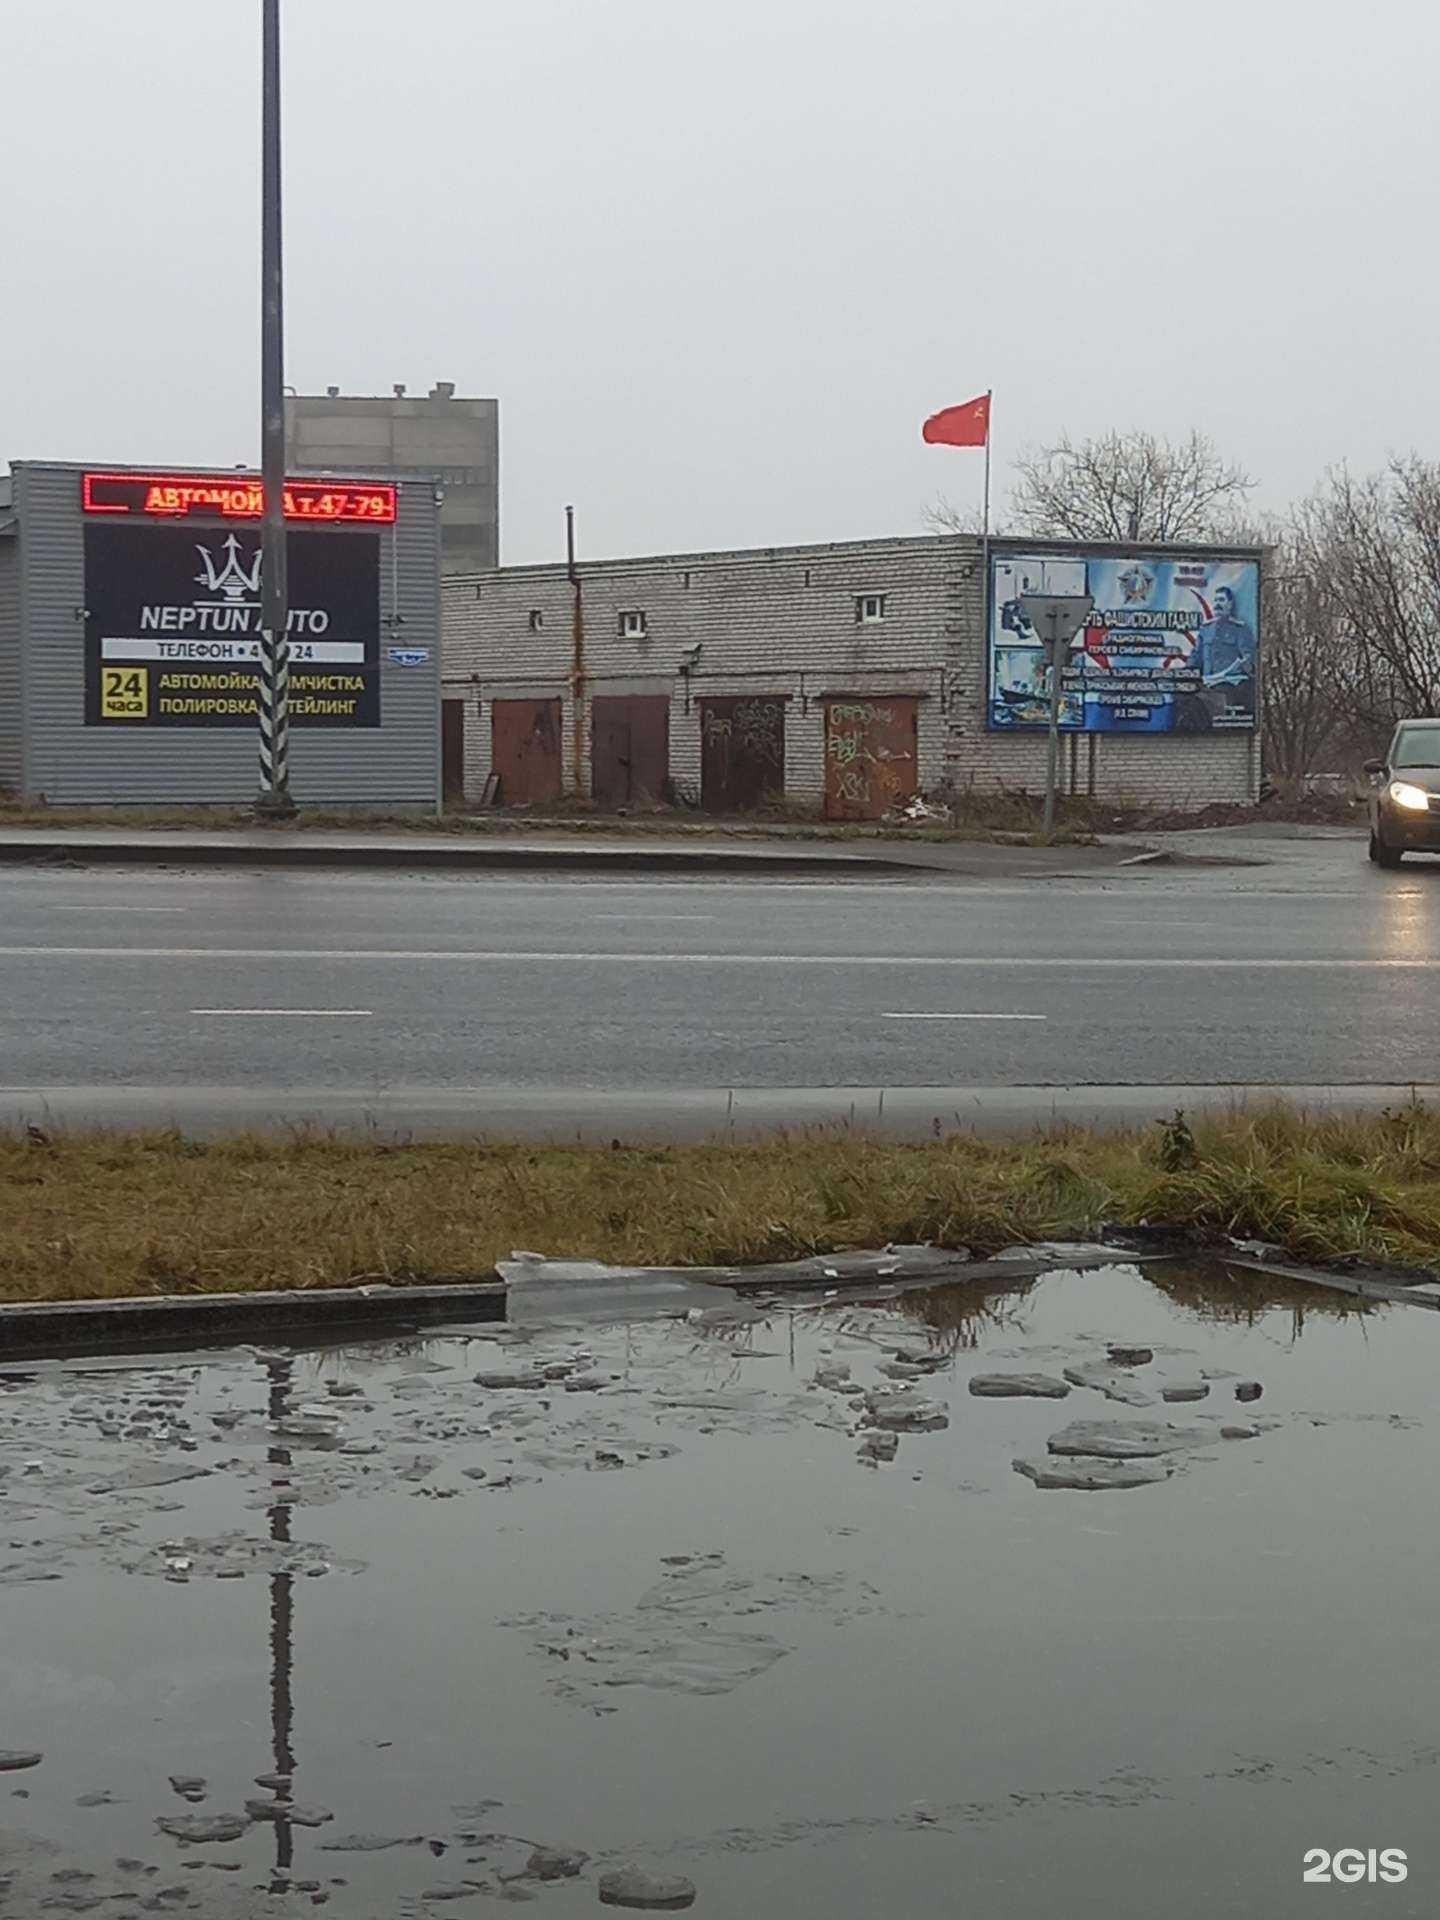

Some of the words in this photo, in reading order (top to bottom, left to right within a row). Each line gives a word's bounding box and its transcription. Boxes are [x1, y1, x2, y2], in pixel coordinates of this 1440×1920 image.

[148, 485, 296, 513] АВТОМОЙА
[140, 606, 250, 632] NEPTUN
[157, 642, 233, 658] ТЕЛЕФОН
[106, 673, 142, 698] 24
[287, 675, 365, 691] МЧИСТКА
[106, 701, 143, 713] часа
[287, 696, 357, 714] ТЕЙЛИНГ
